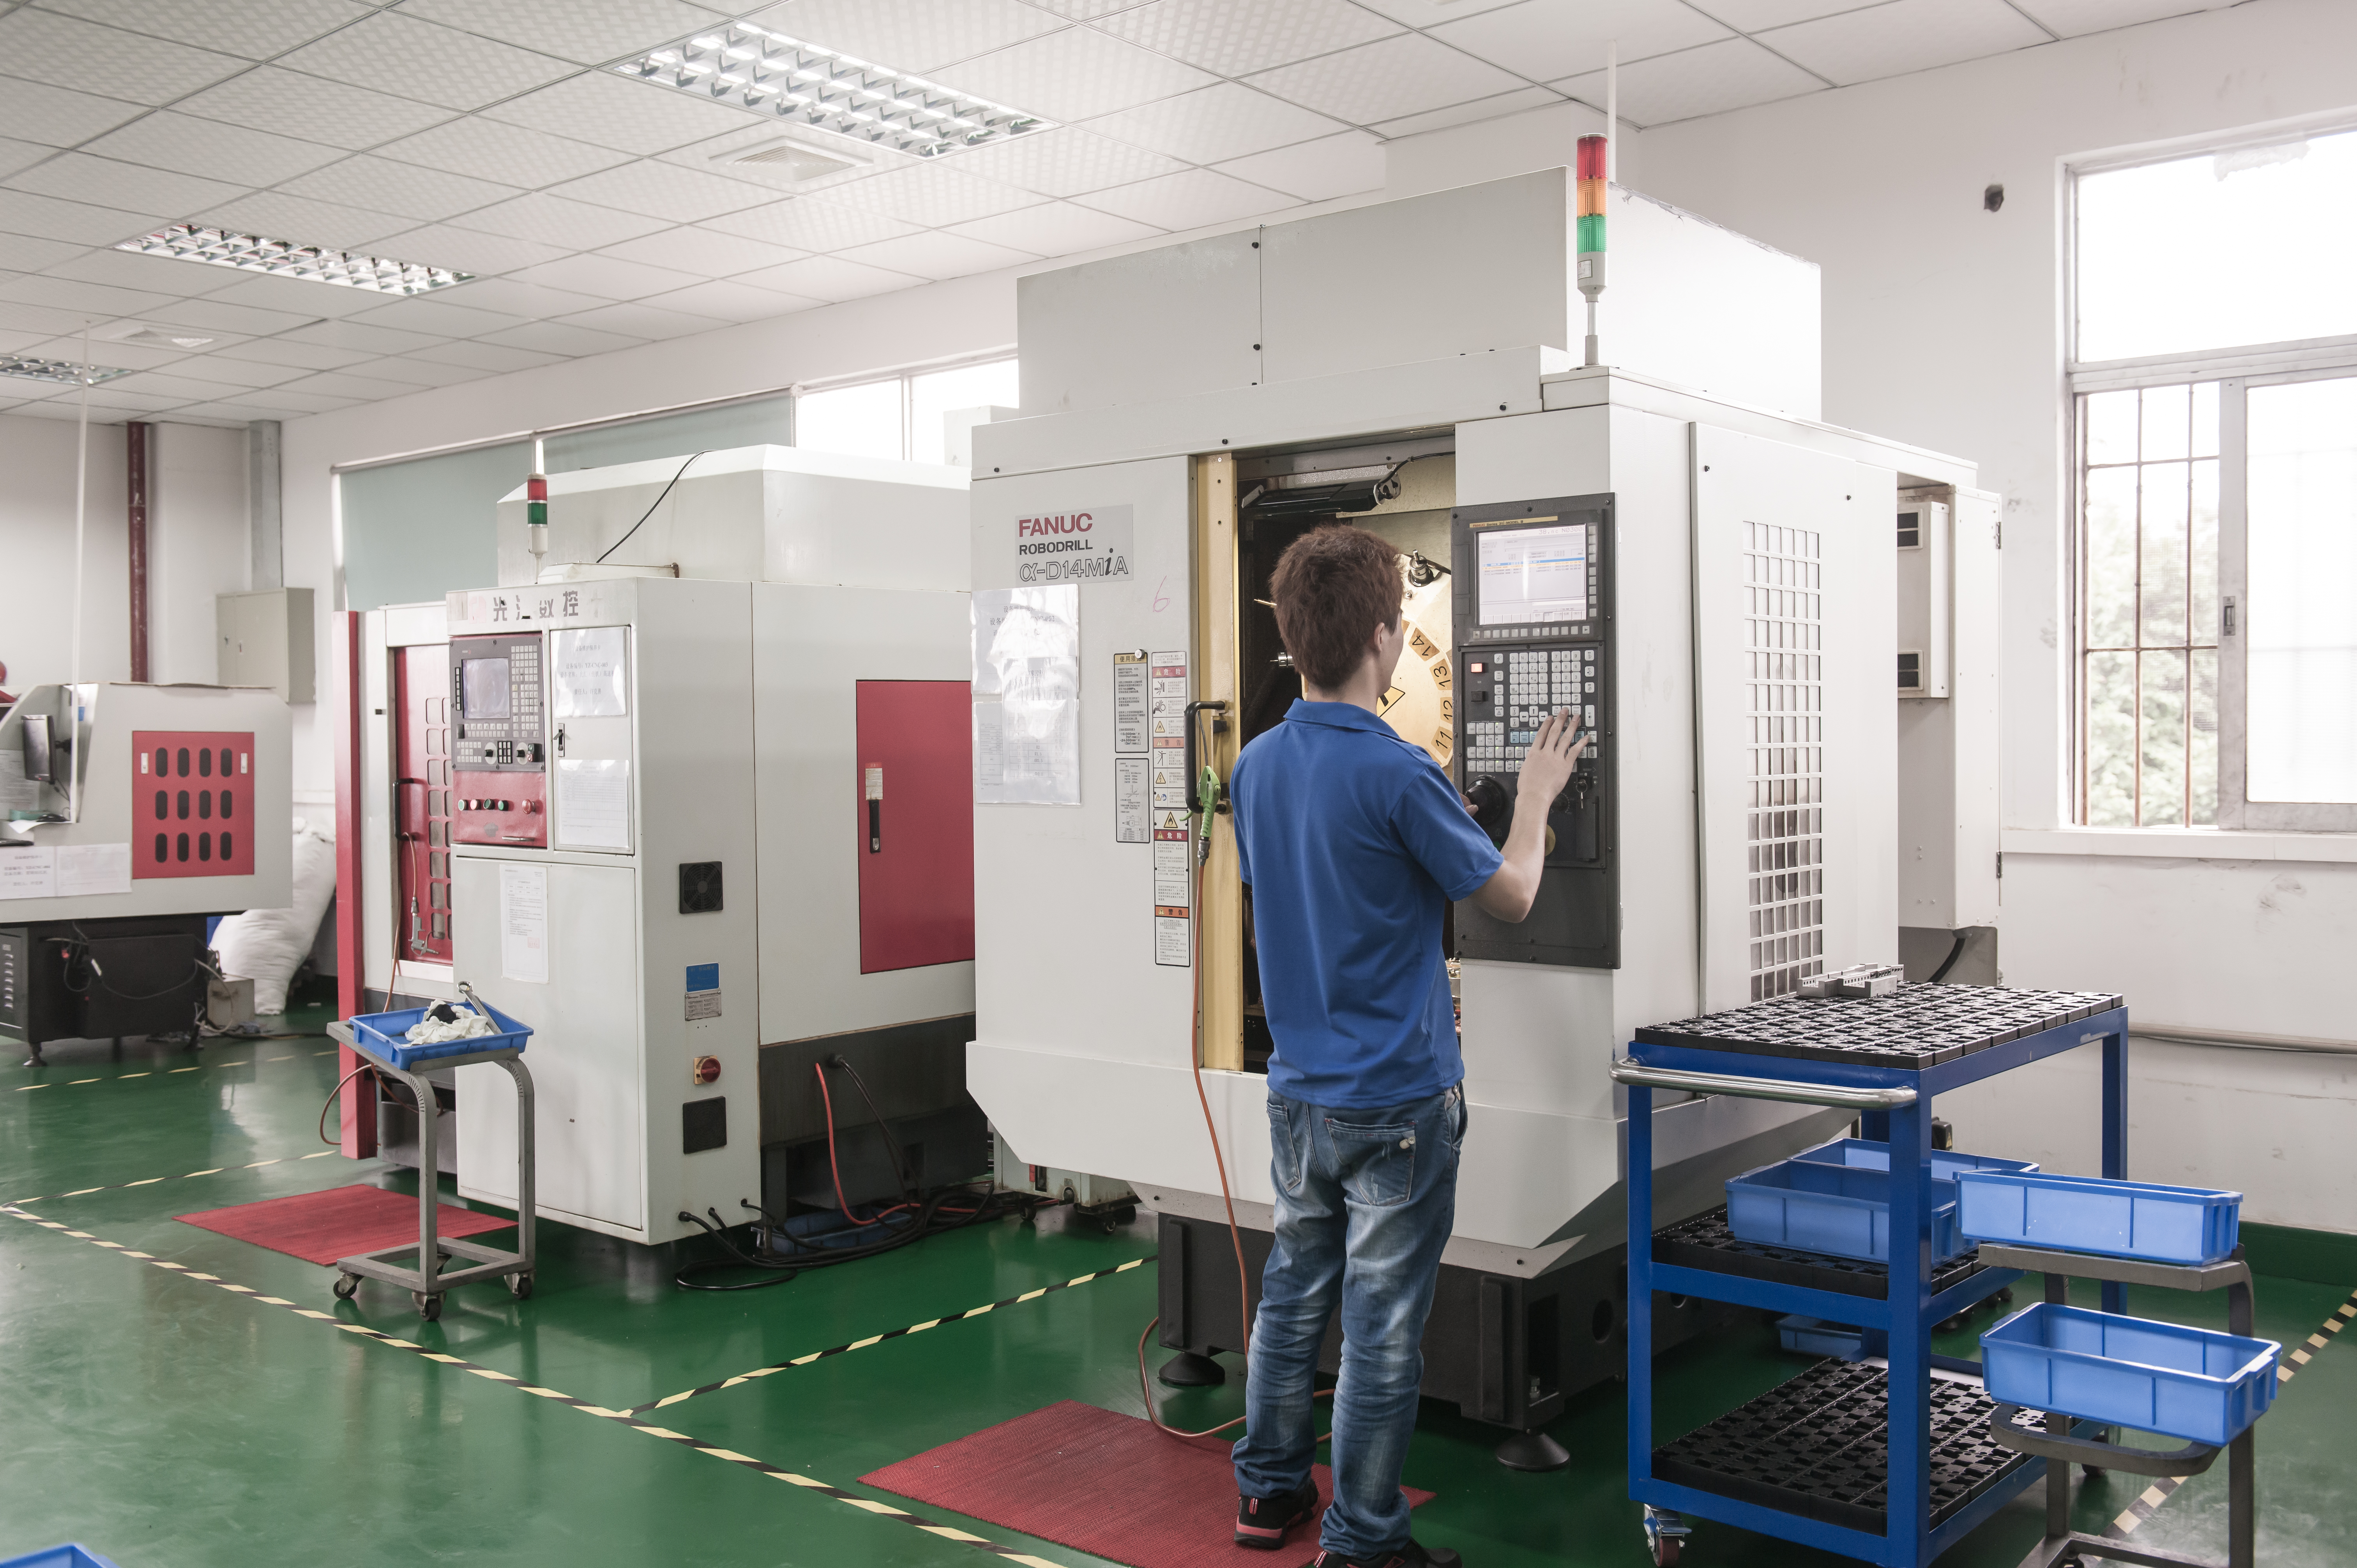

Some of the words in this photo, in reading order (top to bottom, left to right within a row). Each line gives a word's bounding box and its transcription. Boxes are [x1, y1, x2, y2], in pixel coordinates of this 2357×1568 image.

[1019, 513, 1093, 537] FANUC
[1019, 539, 1093, 555] ROBODRILL
[1152, 575, 1171, 613] 6
[1412, 635, 1431, 656] 14
[1433, 666, 1451, 687] 13
[1436, 731, 1452, 749] 11
